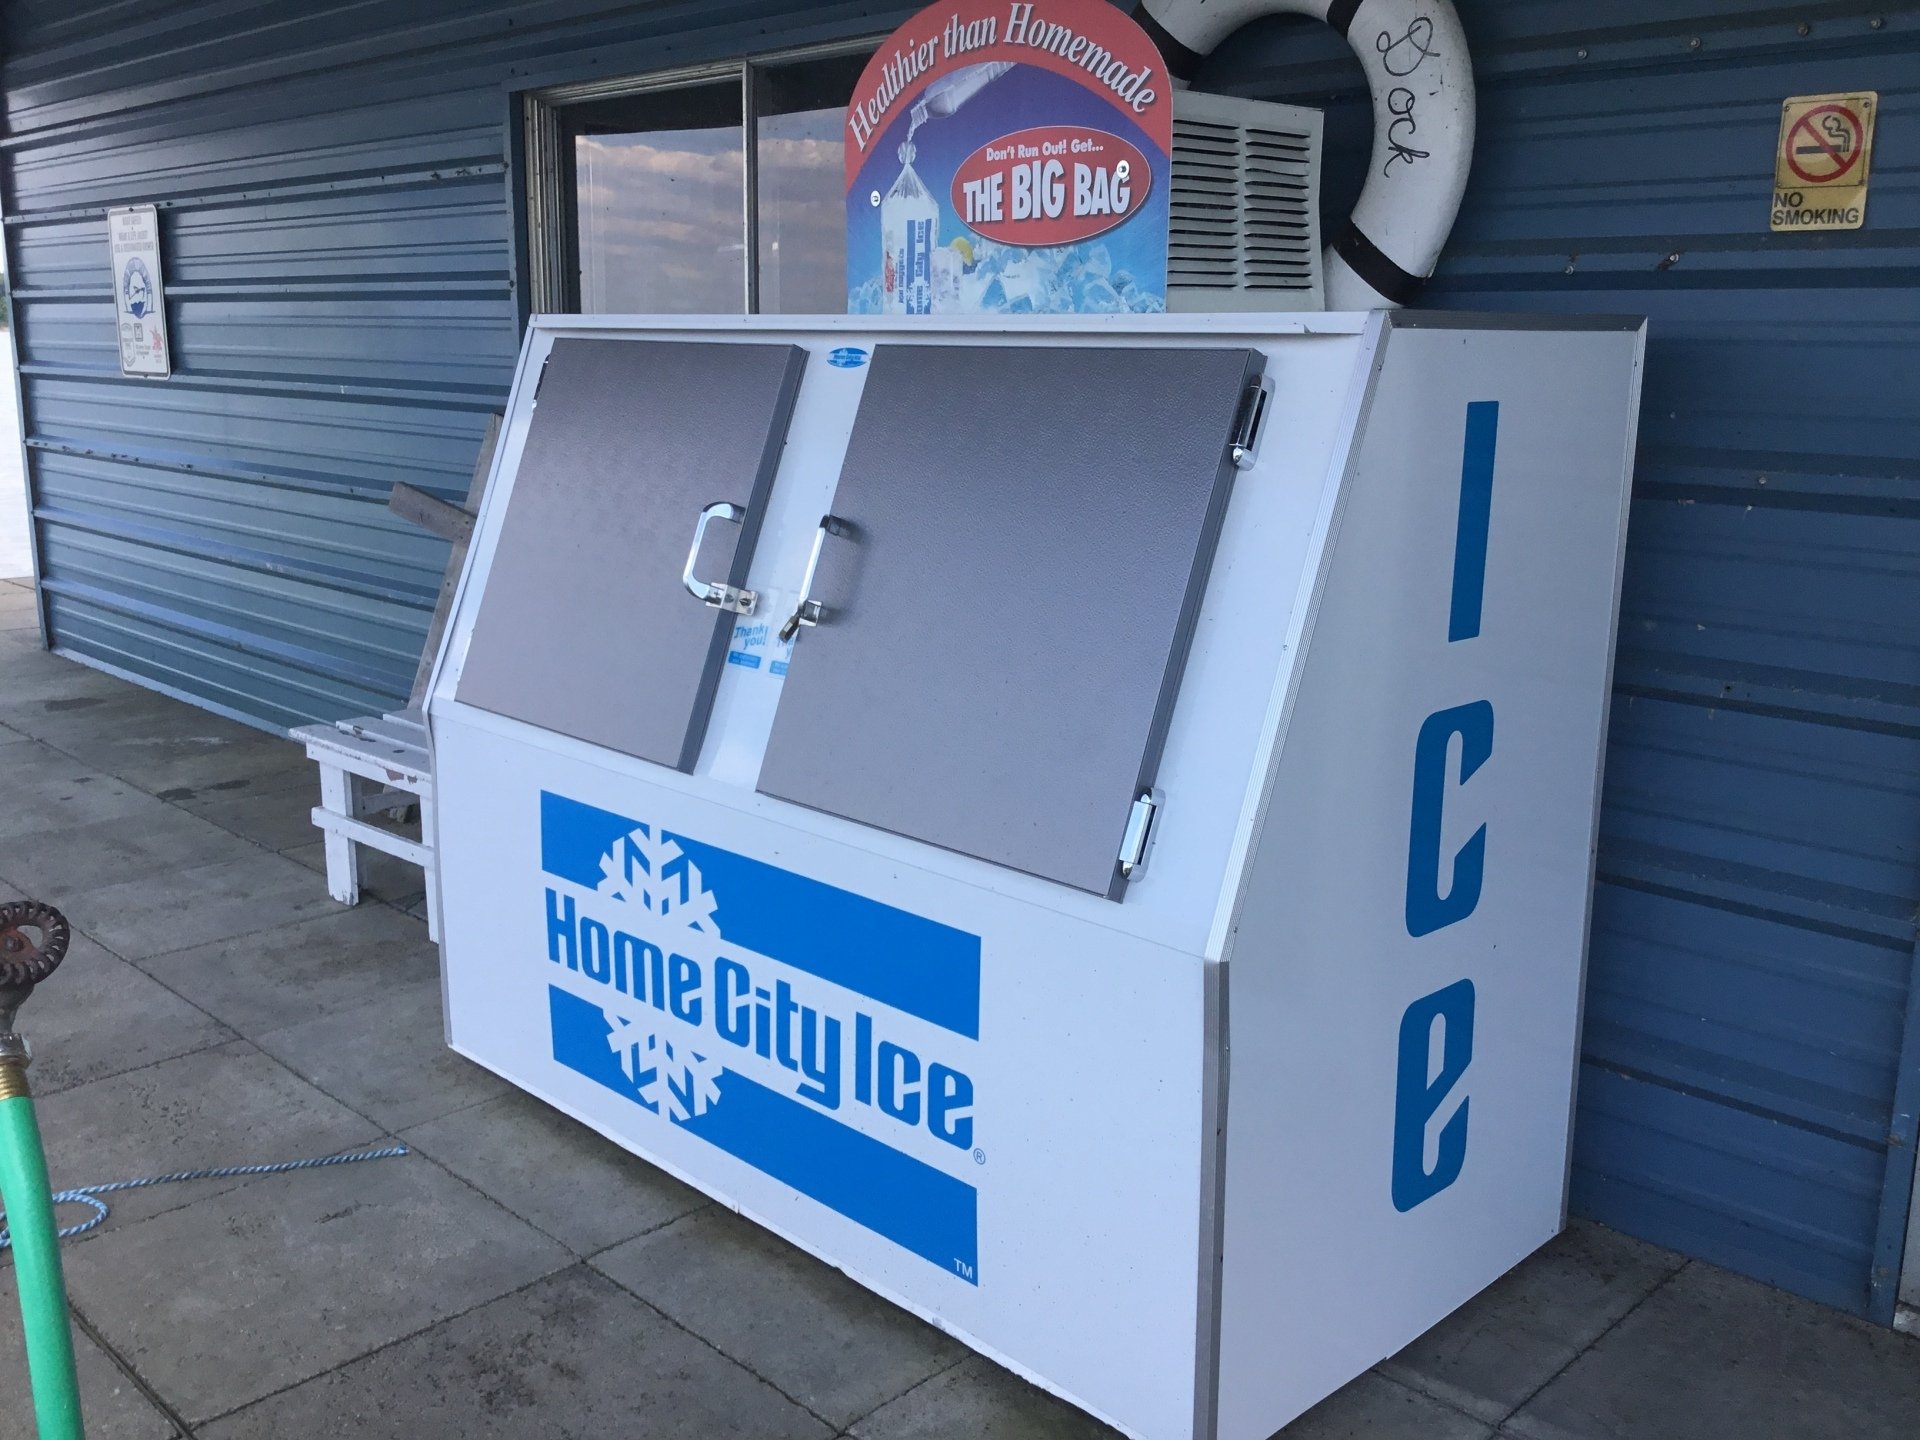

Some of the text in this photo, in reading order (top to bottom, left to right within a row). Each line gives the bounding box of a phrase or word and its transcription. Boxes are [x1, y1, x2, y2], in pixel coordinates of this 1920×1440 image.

[848, 2, 1155, 152] Healthier than Homemade
[1376, 16, 1440, 178] Dock
[986, 138, 1104, 162] Don't Run Out! Get...
[963, 159, 1131, 223] THE BIG BAG
[1773, 192, 1804, 208] NO
[1772, 208, 1859, 226] SMOKING
[734, 623, 765, 639] Thank
[545, 887, 702, 1027] Home
[714, 956, 841, 1111] City
[855, 1011, 973, 1150] Ice
[953, 1258, 973, 1279] TM
